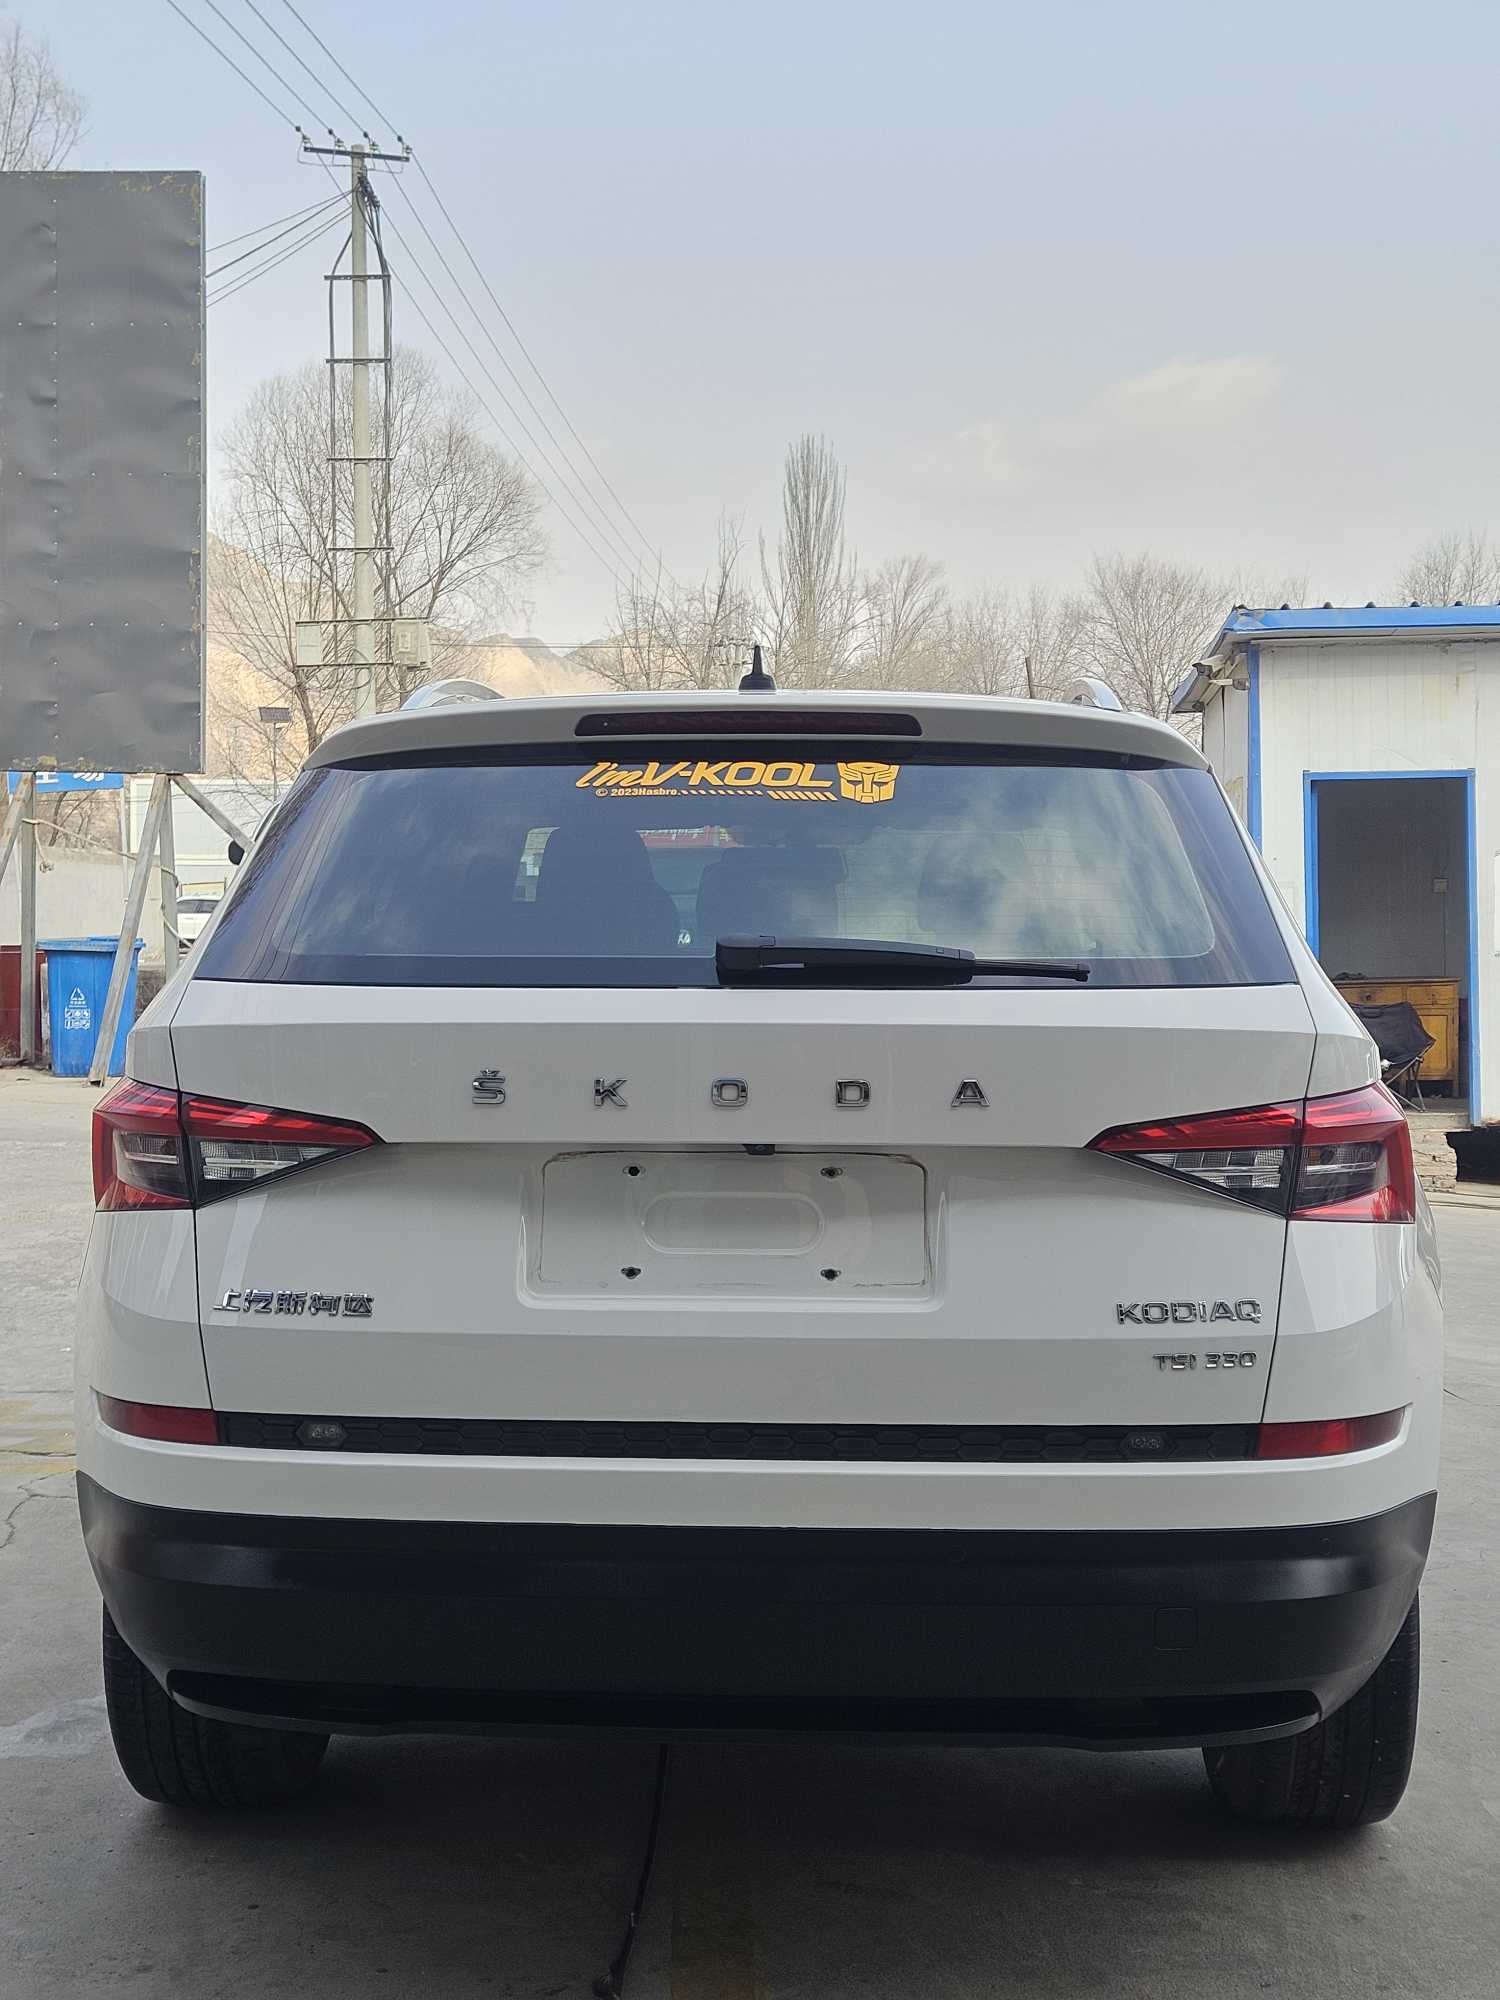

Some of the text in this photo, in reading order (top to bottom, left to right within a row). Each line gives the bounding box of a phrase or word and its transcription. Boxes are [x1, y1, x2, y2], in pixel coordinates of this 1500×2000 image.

[212, 1288, 375, 1318] 上汽斯柯达
[1116, 1299, 1263, 1325] KODIAQ
[1152, 1351, 1257, 1371] TSI 330
